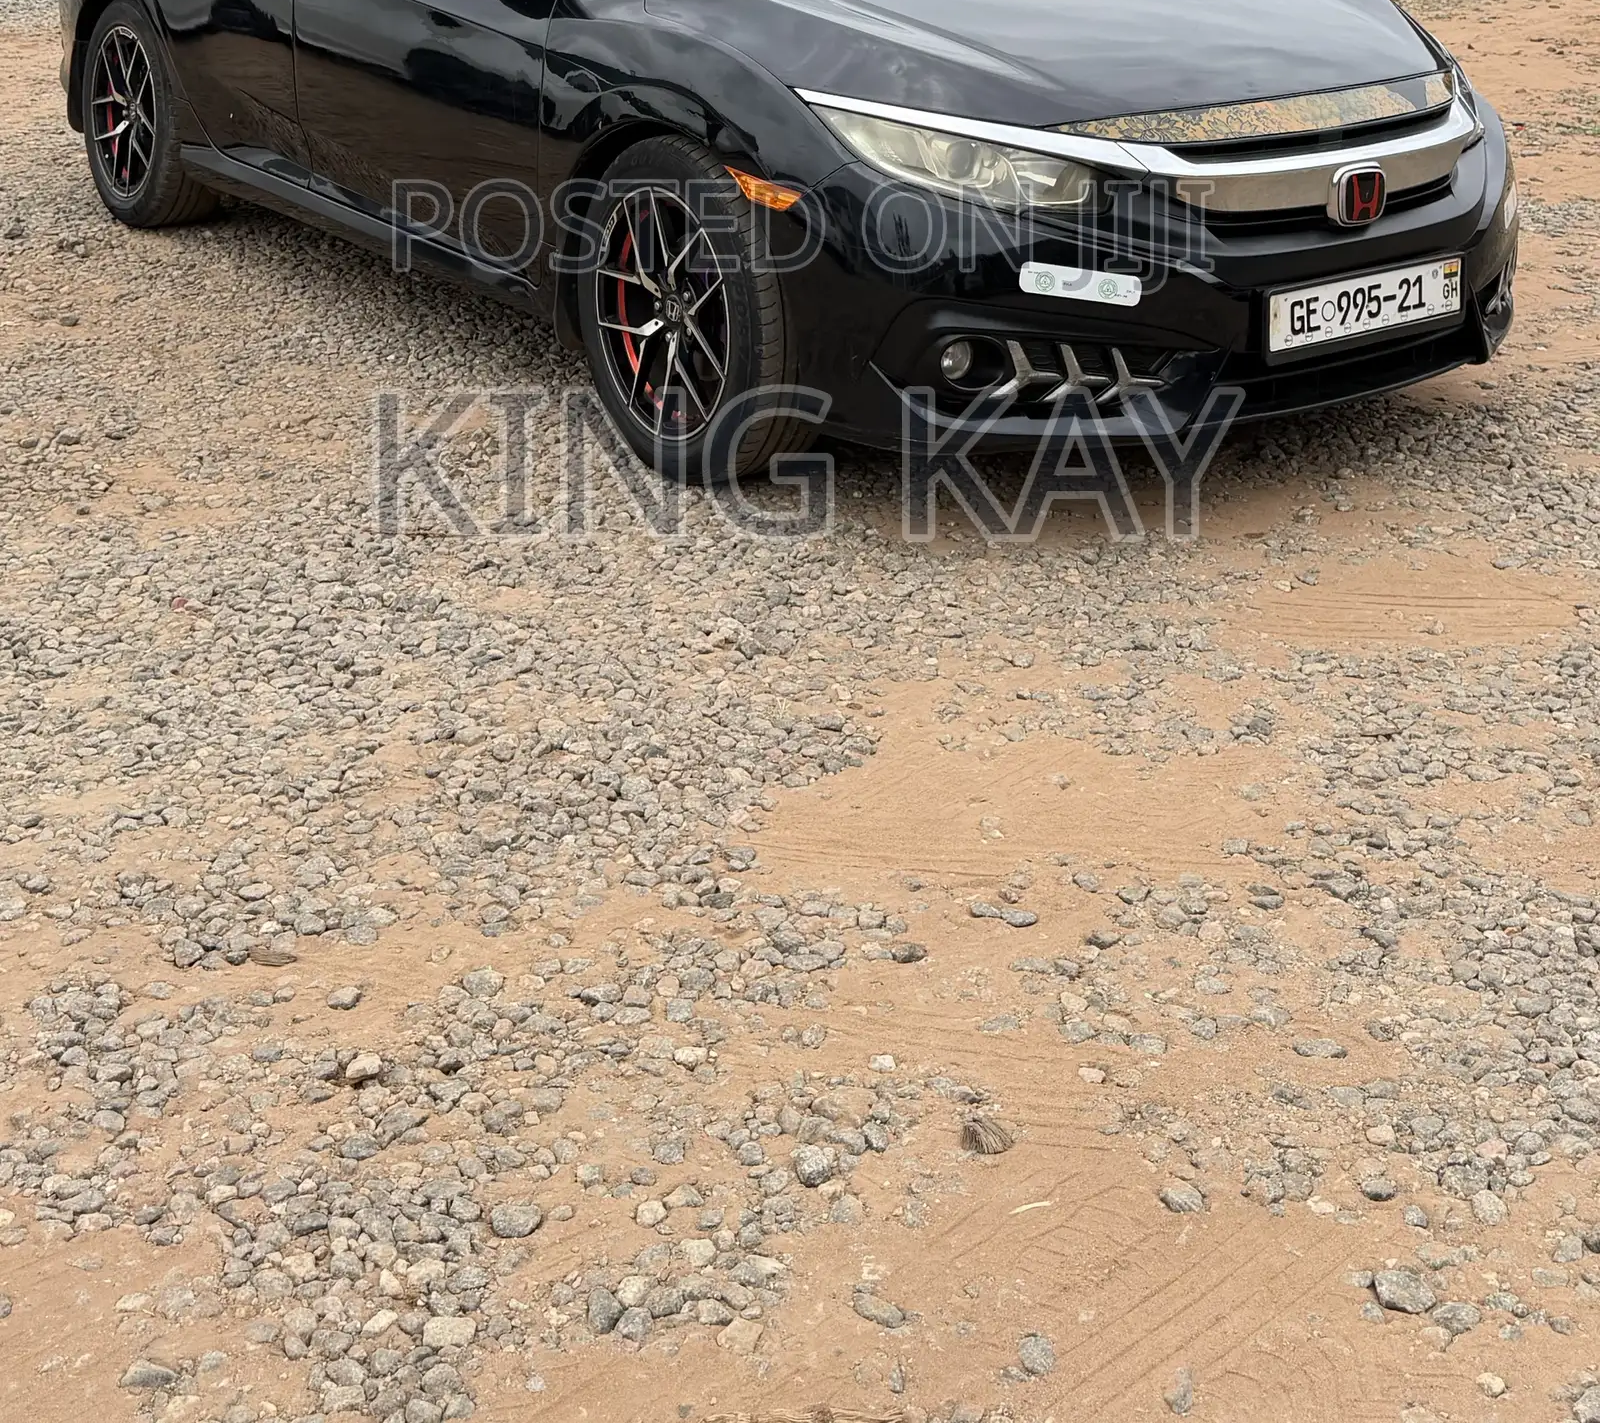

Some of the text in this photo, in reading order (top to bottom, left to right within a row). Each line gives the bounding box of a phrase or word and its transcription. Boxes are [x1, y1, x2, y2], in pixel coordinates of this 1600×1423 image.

[1290, 275, 1426, 335] GE 995-21
[1443, 280, 1458, 300] GH
